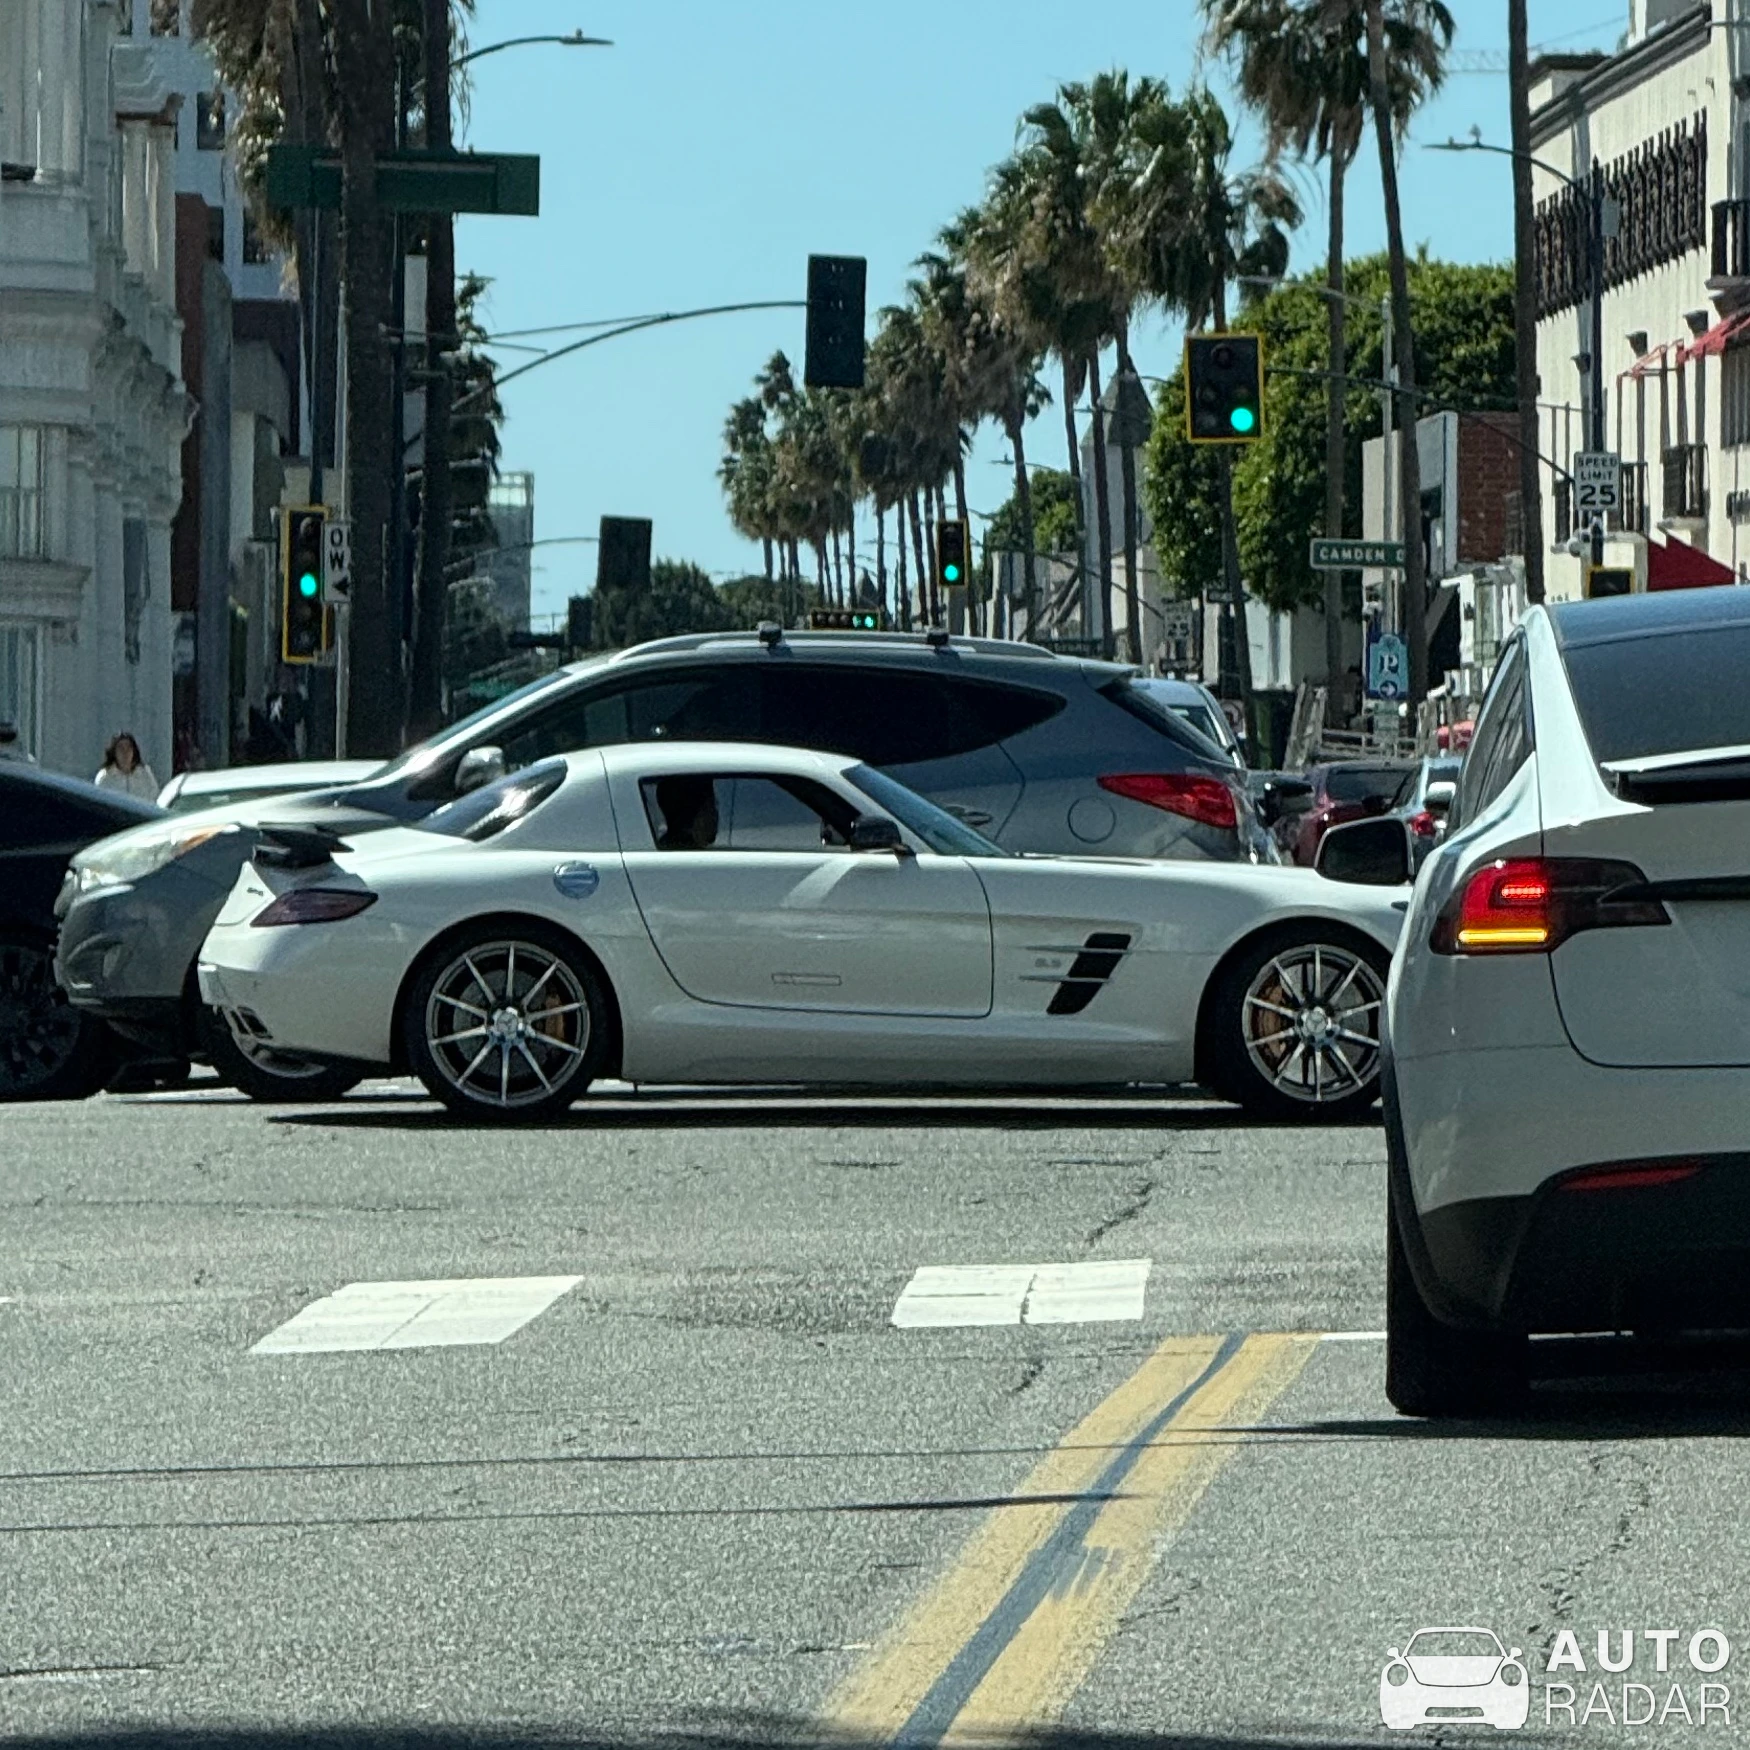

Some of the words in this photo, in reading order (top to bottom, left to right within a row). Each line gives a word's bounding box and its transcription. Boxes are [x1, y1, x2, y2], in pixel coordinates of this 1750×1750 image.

[1578, 456, 1618, 468] SPEED
[1580, 470, 1613, 481] LIMIT
[1580, 484, 1616, 505] 25
[1319, 546, 1385, 562] CAMDEN
[1380, 653, 1399, 674] P
